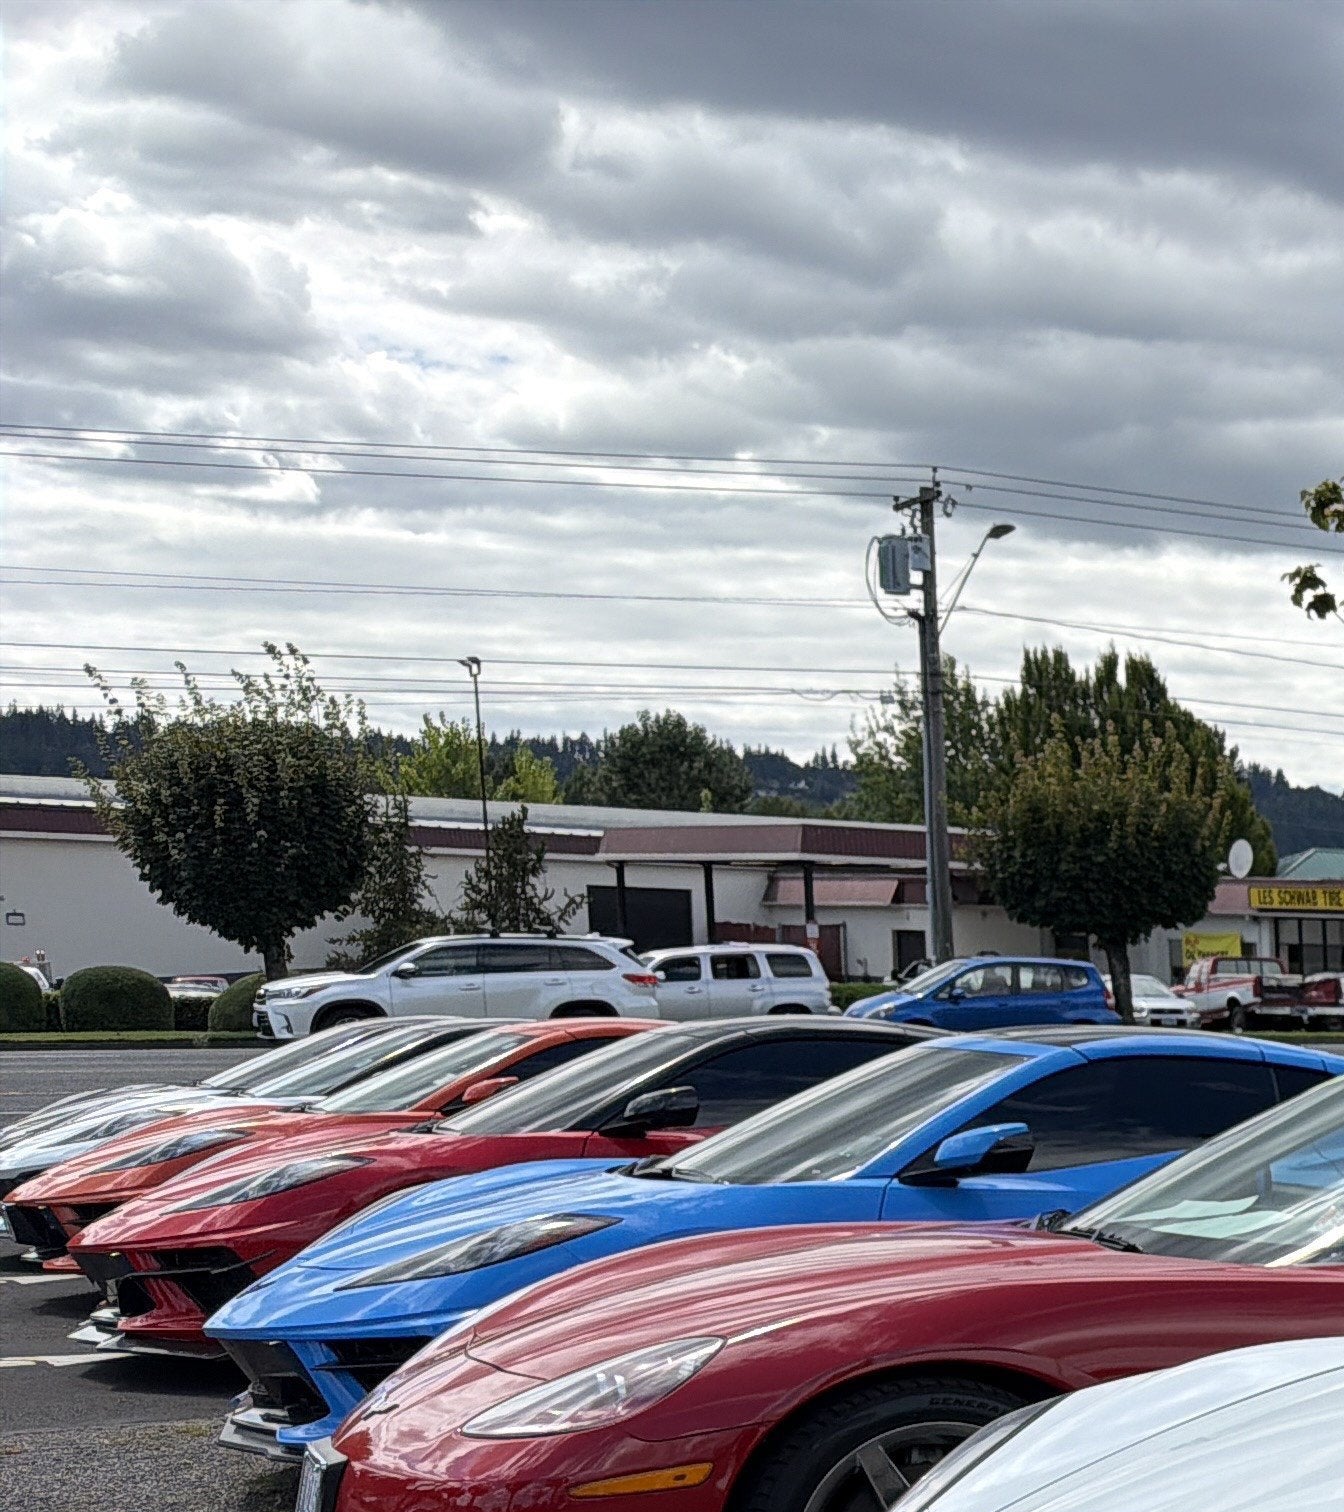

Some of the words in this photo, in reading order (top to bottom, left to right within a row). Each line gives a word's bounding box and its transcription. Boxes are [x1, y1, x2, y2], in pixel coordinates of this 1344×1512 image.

[1257, 890, 1274, 906] LES
[1278, 890, 1318, 907] SCHWAB
[1322, 890, 1343, 908] TIRE
